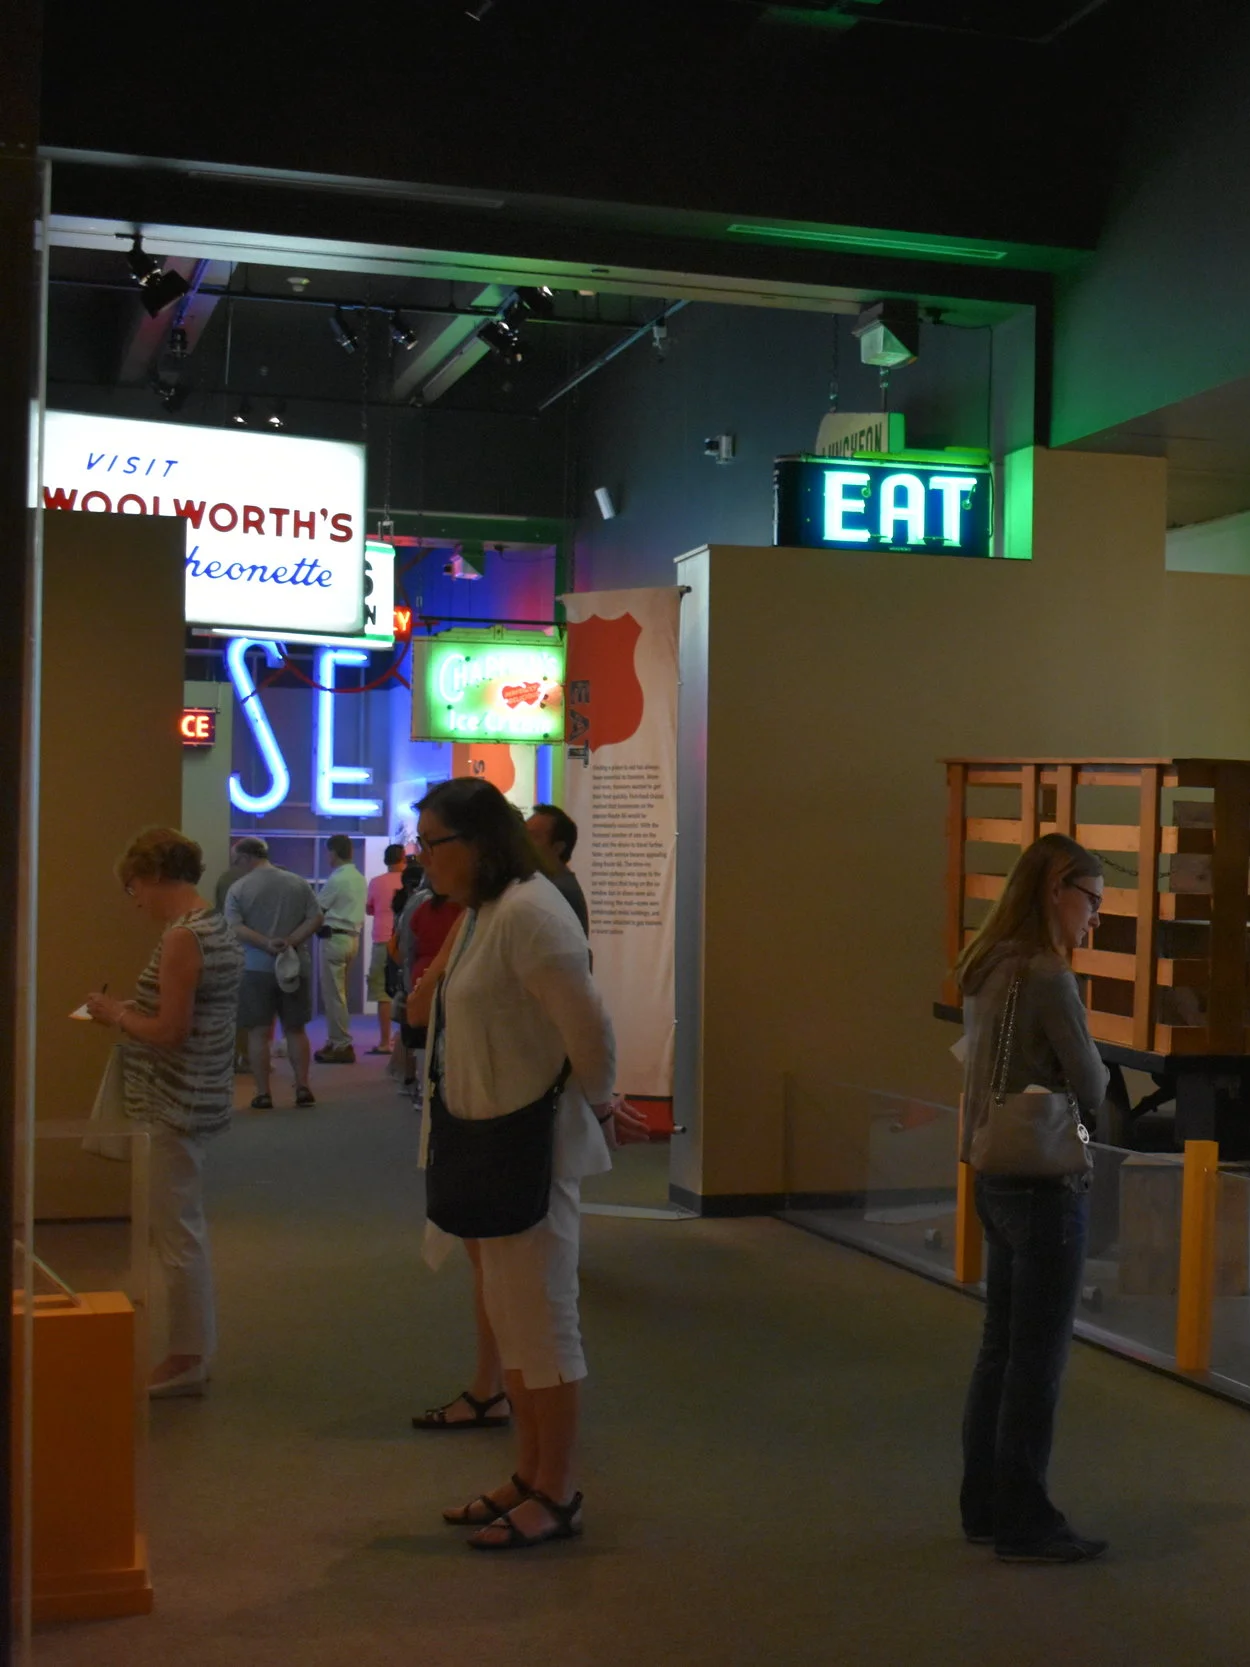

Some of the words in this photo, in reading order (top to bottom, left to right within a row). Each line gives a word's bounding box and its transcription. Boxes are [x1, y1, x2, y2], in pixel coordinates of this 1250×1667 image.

[86, 452, 179, 478] VISIT
[822, 470, 978, 547] EAT
[185, 545, 333, 588] heonette
[567, 680, 590, 768] EAT
